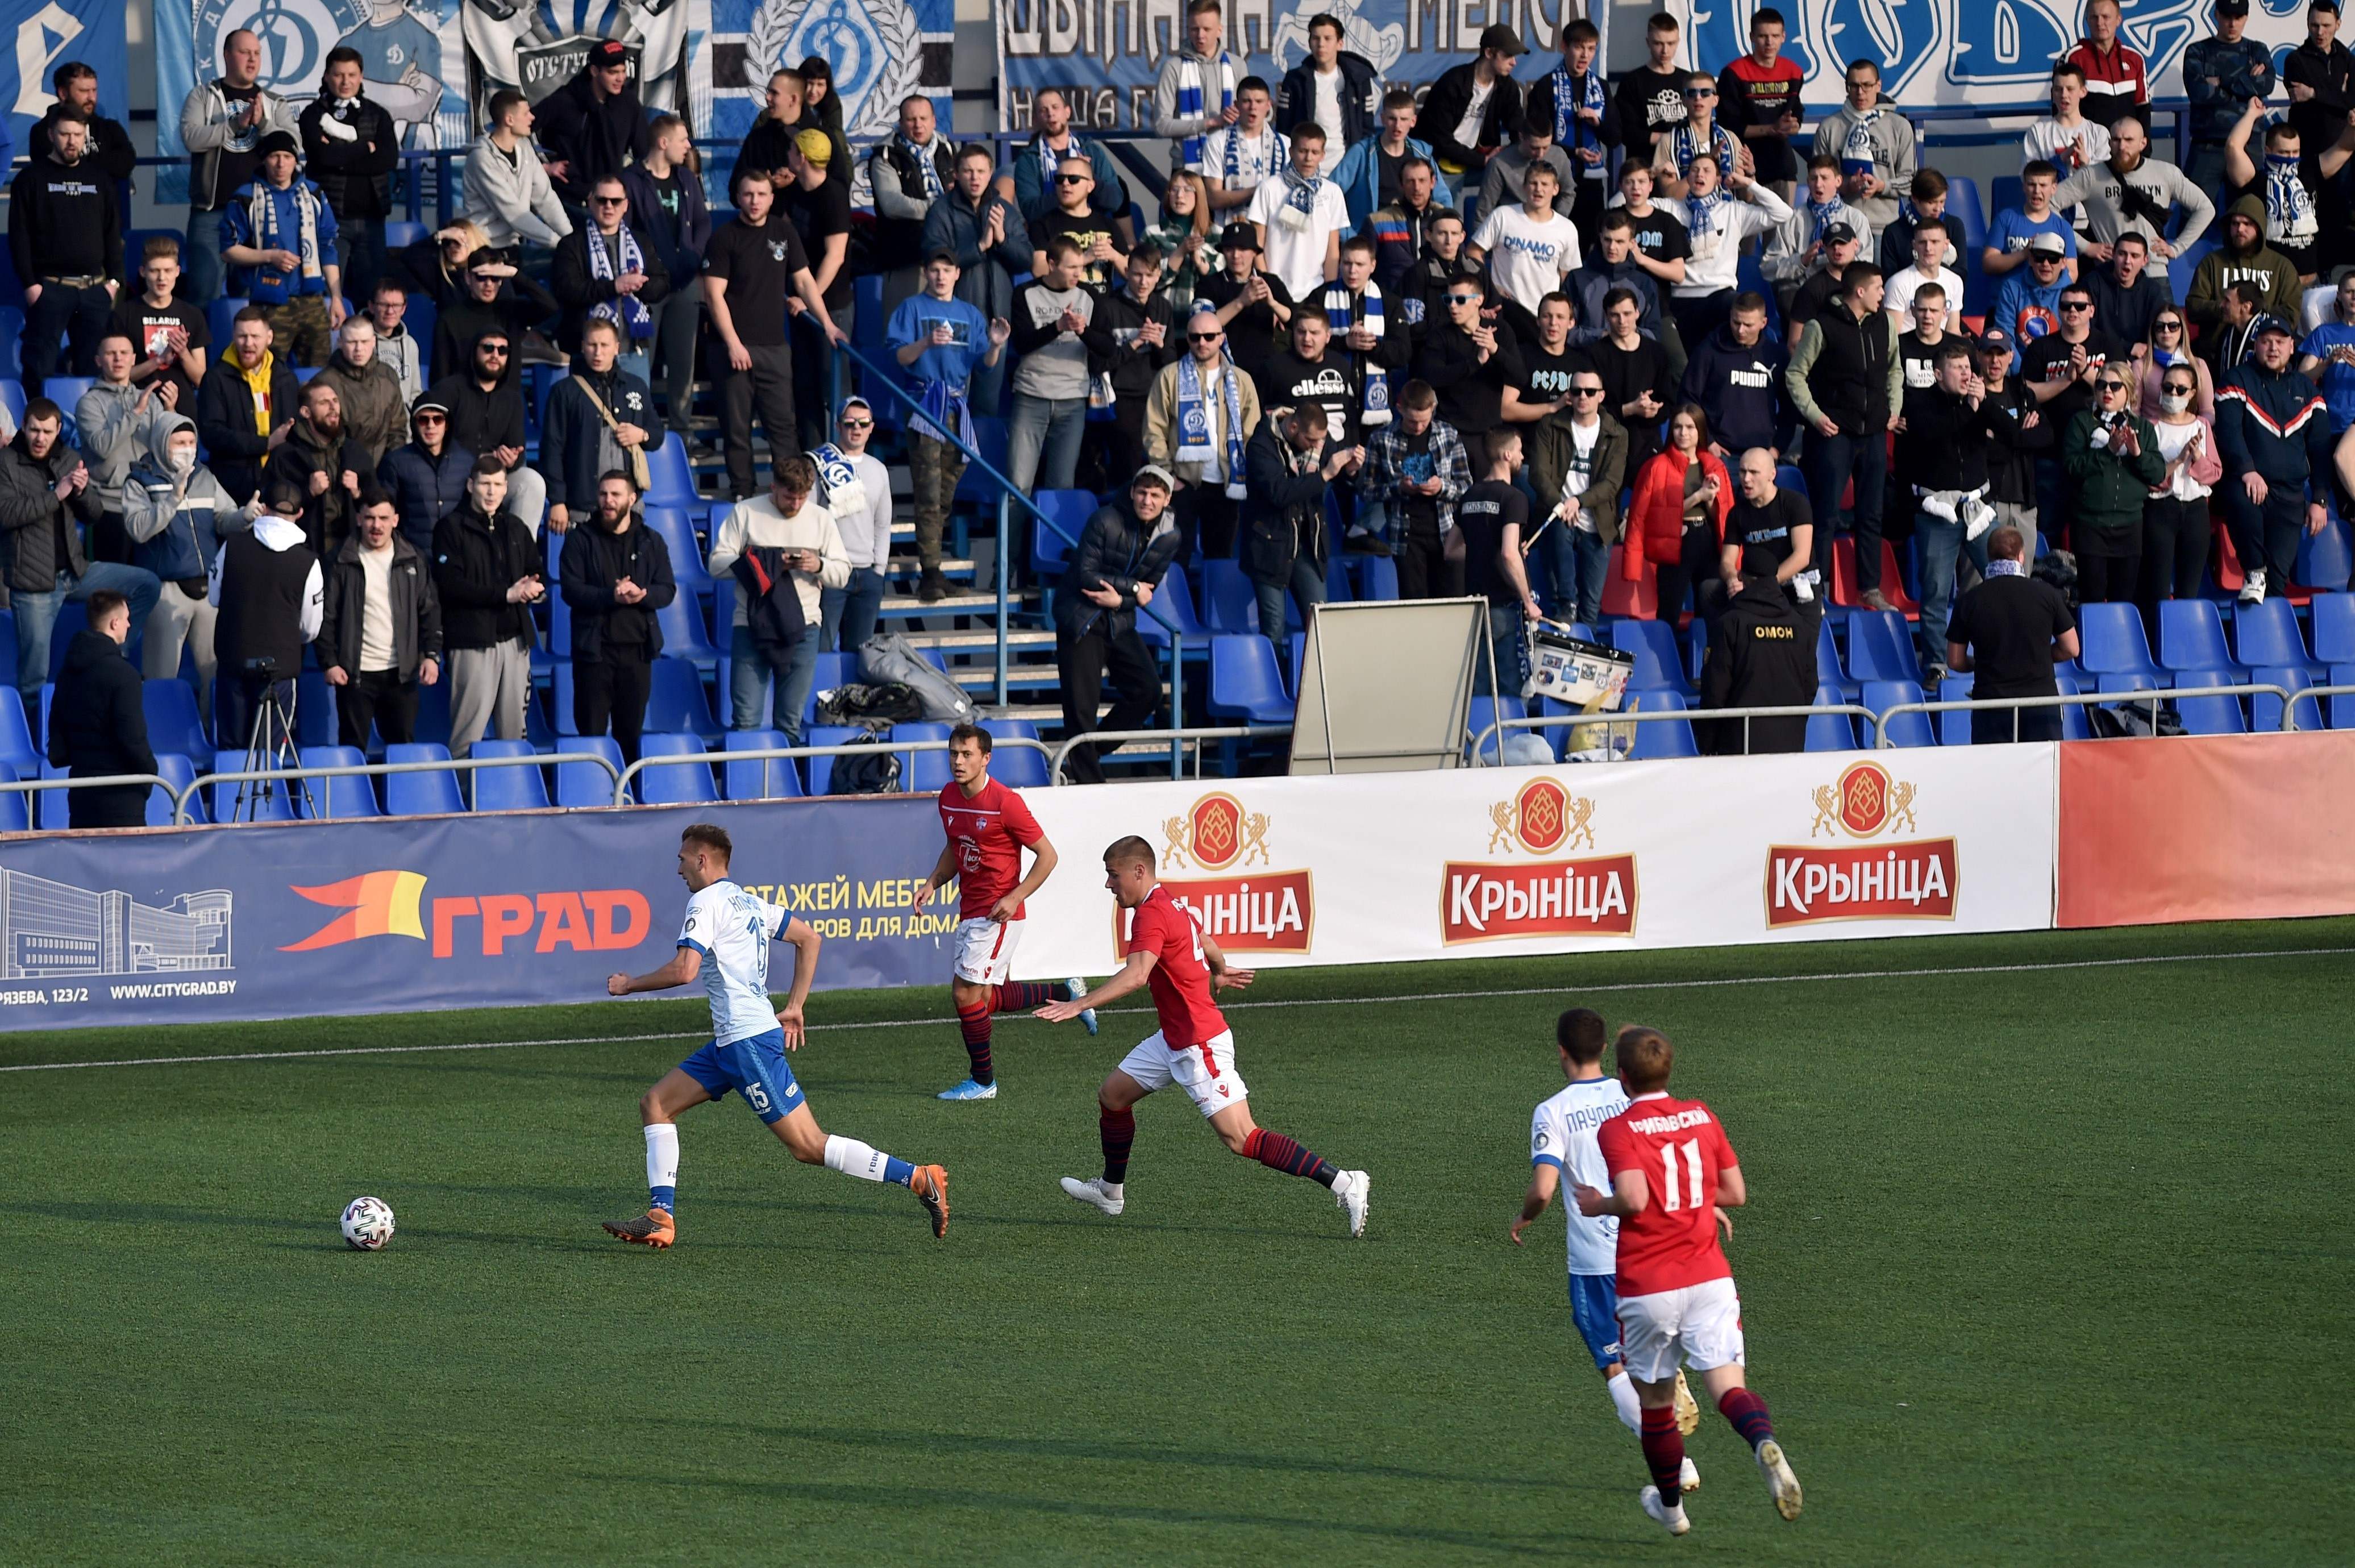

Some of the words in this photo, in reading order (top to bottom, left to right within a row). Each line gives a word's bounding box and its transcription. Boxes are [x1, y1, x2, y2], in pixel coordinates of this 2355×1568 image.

[142, 317, 181, 326] BELARUS
[1730, 370, 1767, 388] PUMA
[1755, 626, 1793, 639] ОМОН
[432, 888, 651, 958] ГРАД
[804, 919, 851, 939] АРОВ
[856, 916, 901, 941] ДЛЯ
[52, 988, 88, 1003] 123/2
[110, 980, 237, 999] WWW.CITYGRAD.BY
[745, 1082, 769, 1109] 15
[1660, 1137, 1704, 1212] 11
